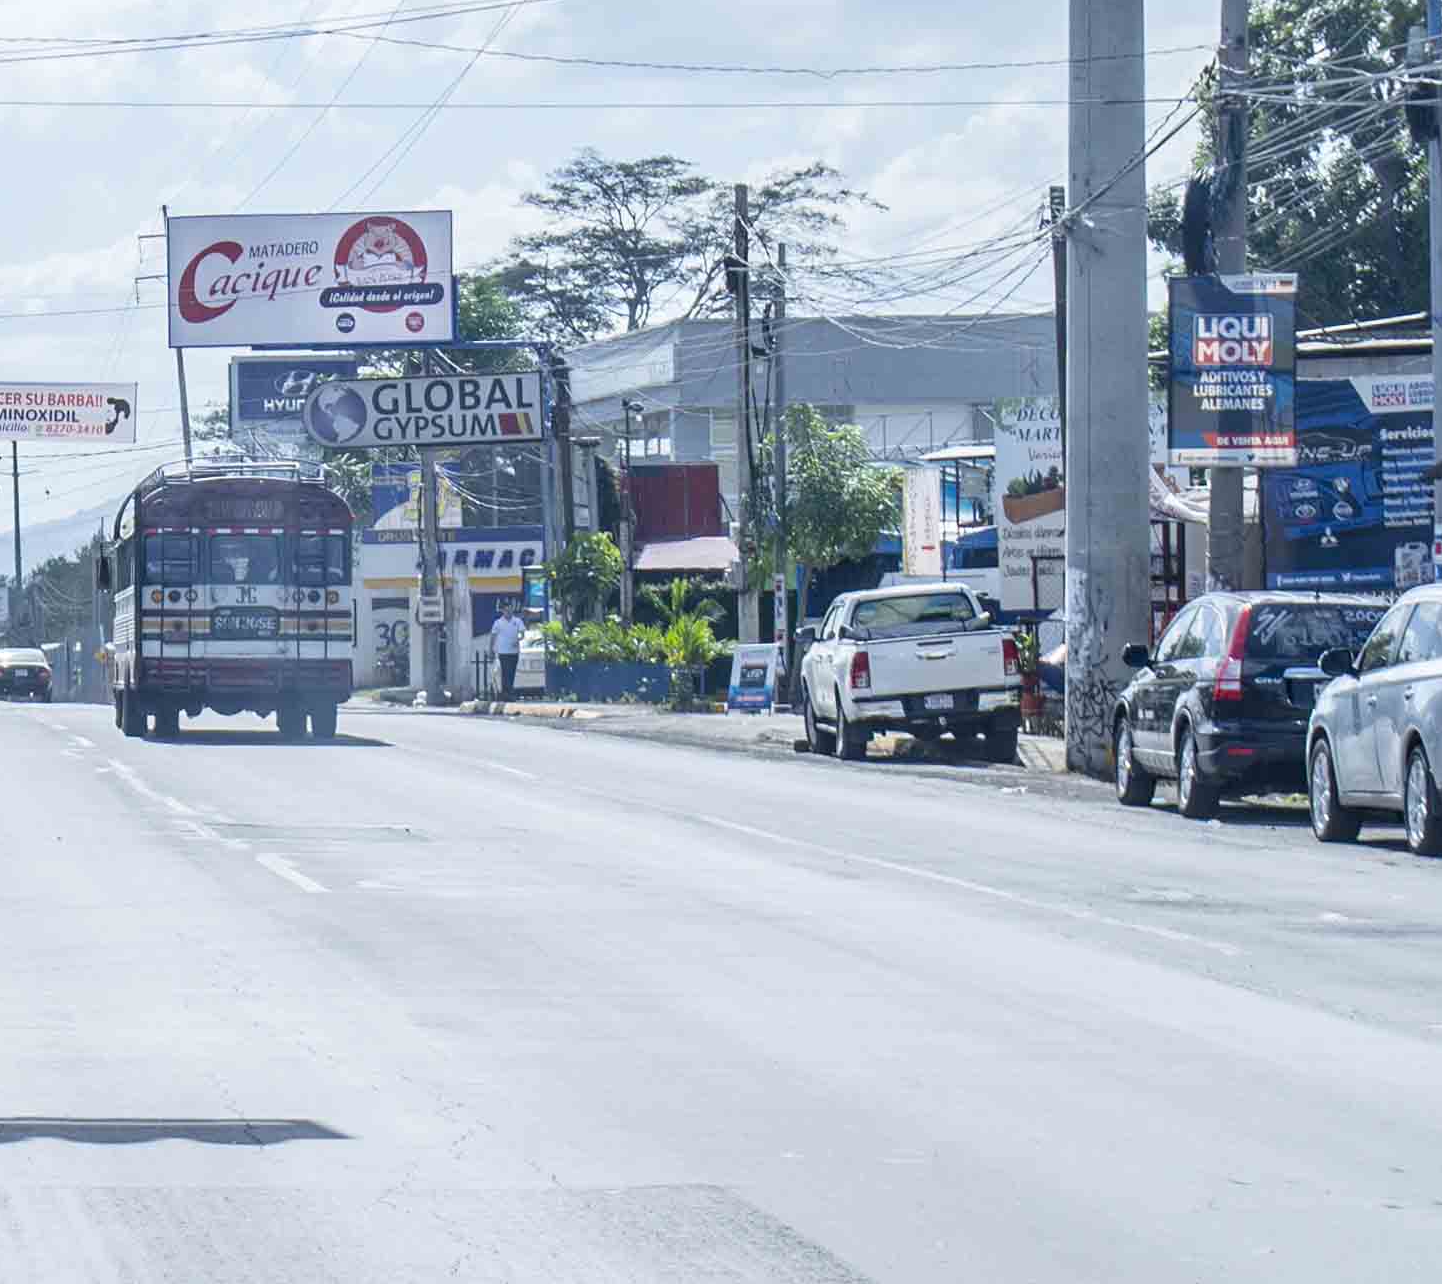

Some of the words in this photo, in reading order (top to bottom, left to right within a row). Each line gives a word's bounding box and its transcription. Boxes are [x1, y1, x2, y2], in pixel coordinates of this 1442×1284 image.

[249, 241, 318, 258] MATADERO
[178, 241, 323, 324] Cacique
[1196, 317, 1272, 339] LIQUI
[1197, 340, 1271, 363] MOLY
[1200, 372, 1257, 383] ADITIVOS
[26, 393, 44, 405] SU
[47, 394, 104, 408] BARBA!!
[371, 377, 534, 416] GLOBAL
[1192, 385, 1274, 398] LUBRICANTES
[1200, 398, 1266, 411] ALEMANES
[373, 413, 498, 442] GYPSUM
